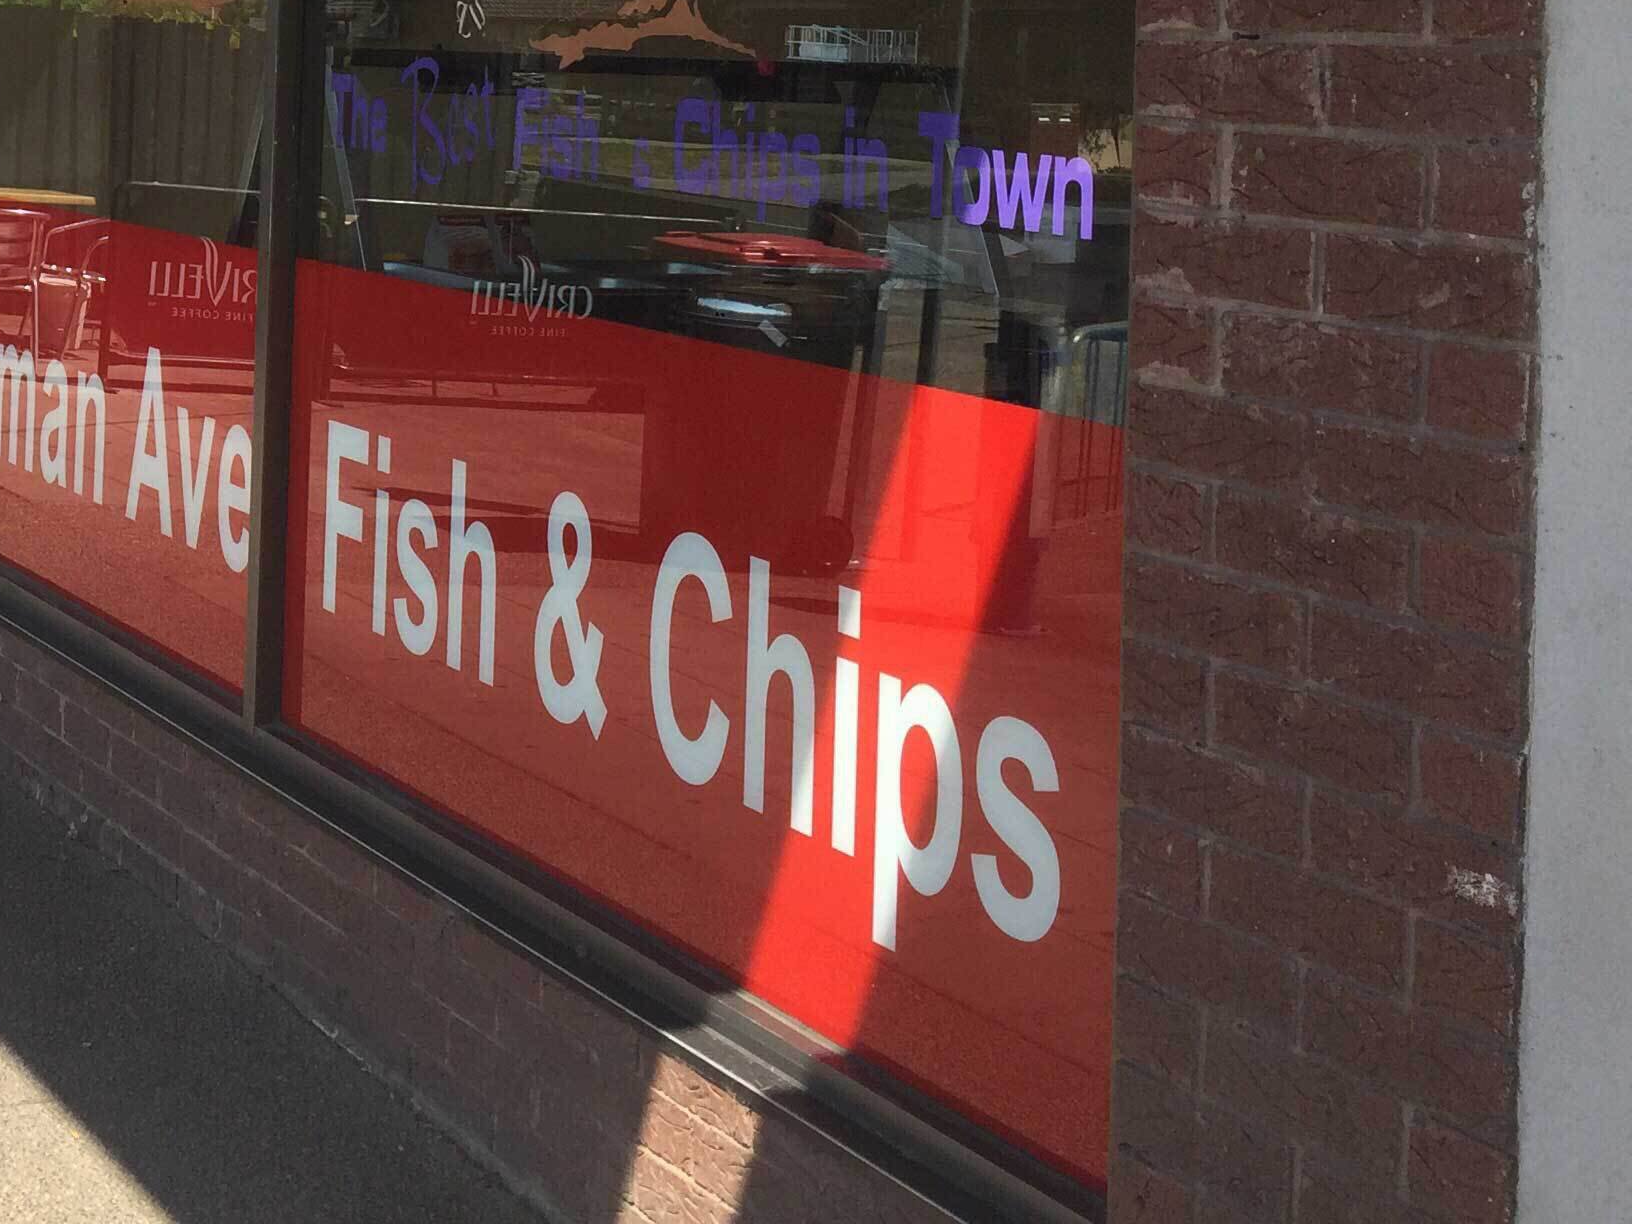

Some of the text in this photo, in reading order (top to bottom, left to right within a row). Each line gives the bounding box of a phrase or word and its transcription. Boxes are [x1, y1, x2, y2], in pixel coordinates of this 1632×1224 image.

[332, 71, 388, 153] The
[400, 57, 497, 195] Best
[512, 87, 601, 183] Fish
[674, 96, 821, 224] Chips
[844, 104, 889, 213] in
[918, 111, 1094, 241] Town
[125, 346, 252, 574] Ave
[322, 419, 496, 688] Fish
[534, 491, 608, 741] &
[650, 532, 1061, 952] Chips
